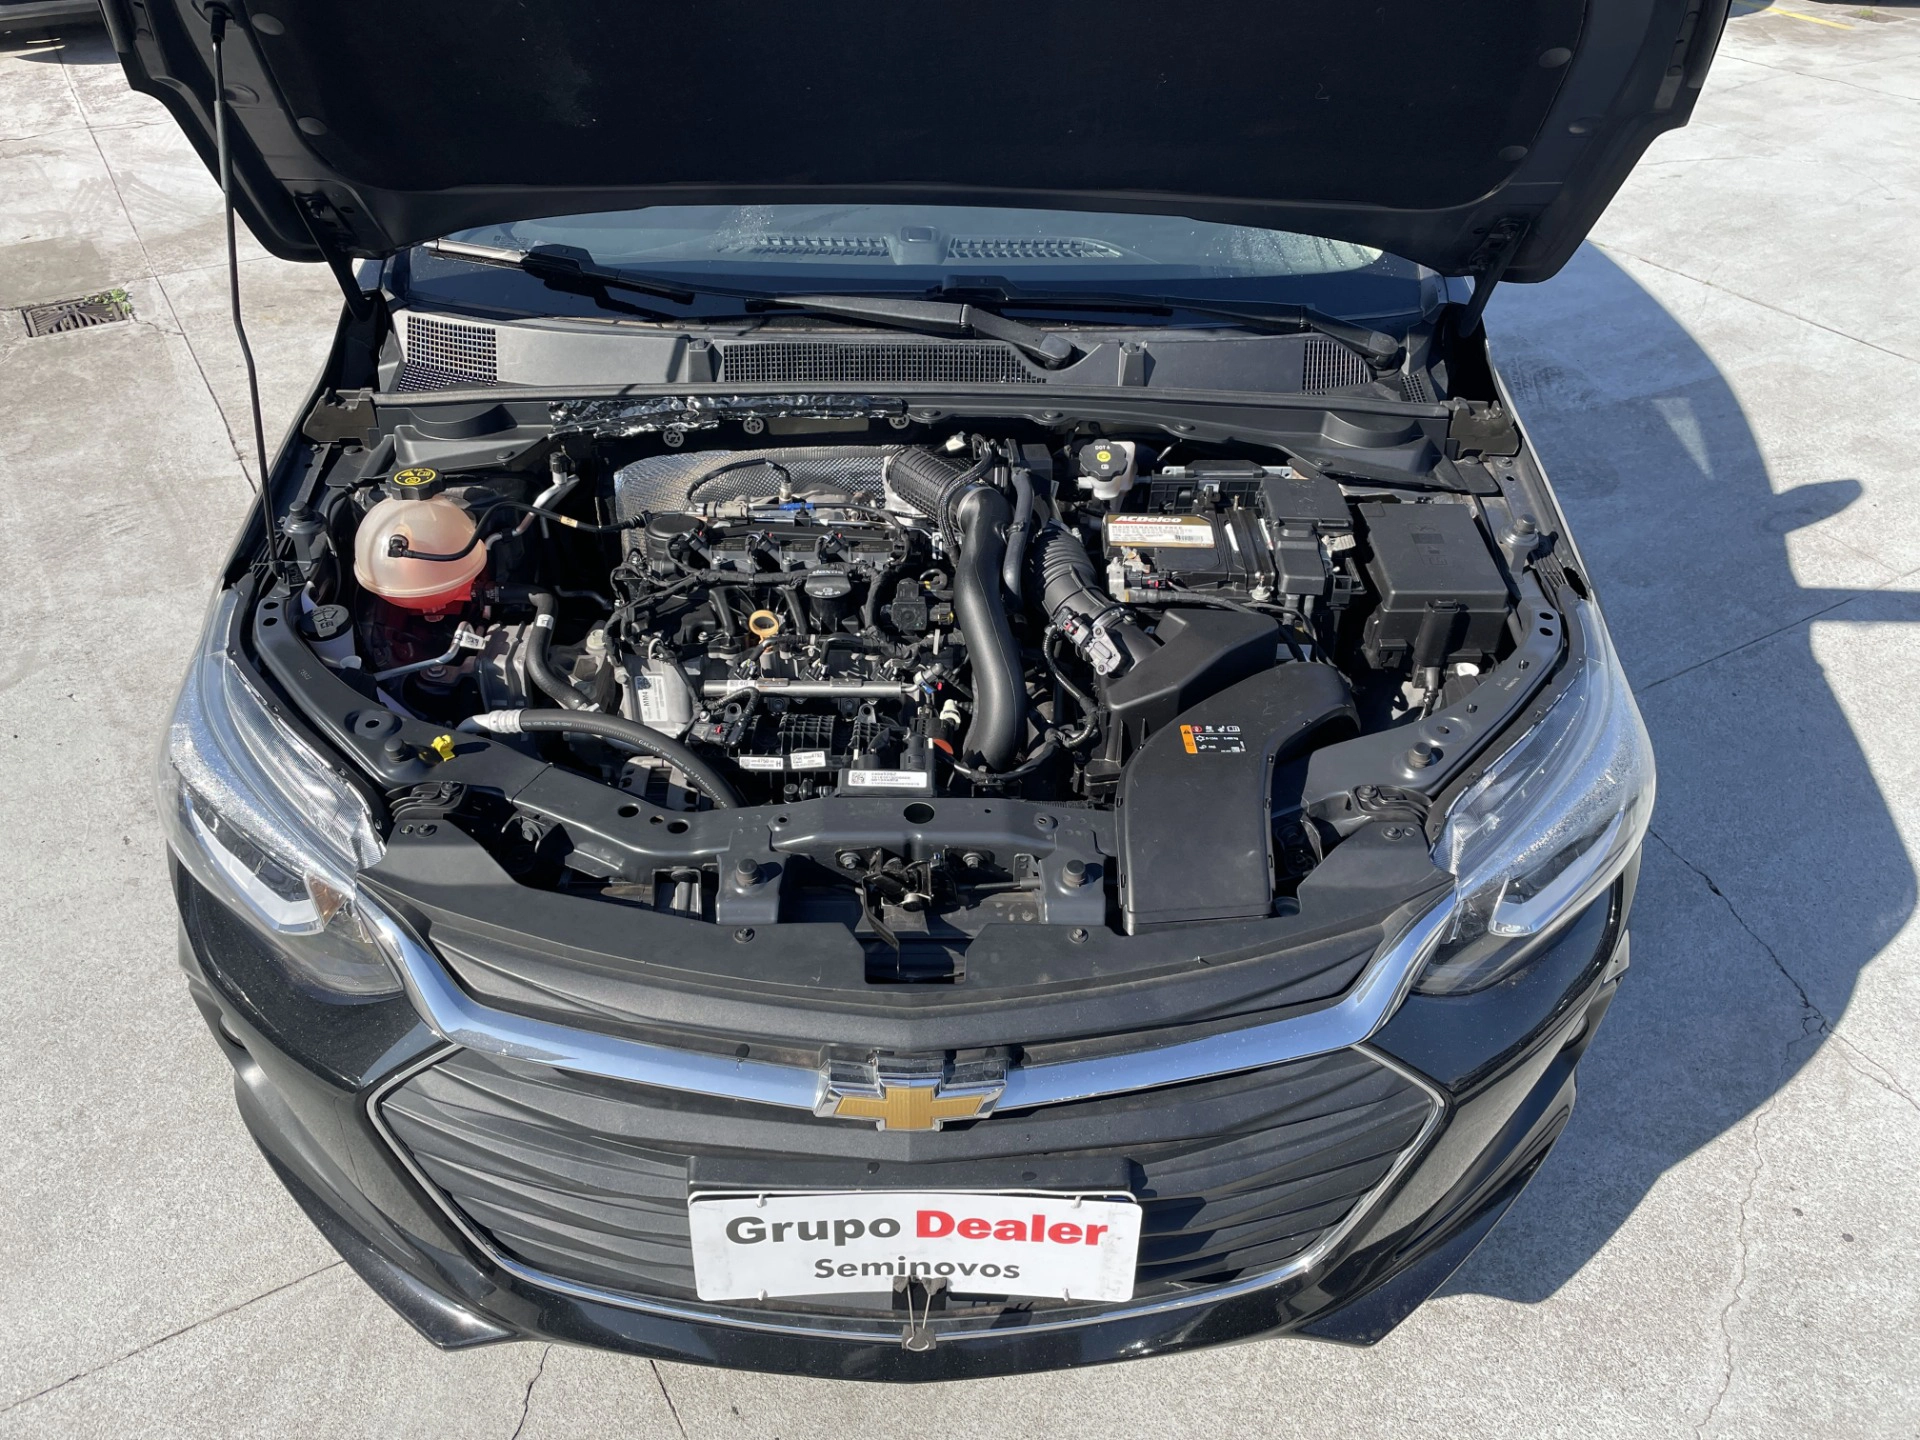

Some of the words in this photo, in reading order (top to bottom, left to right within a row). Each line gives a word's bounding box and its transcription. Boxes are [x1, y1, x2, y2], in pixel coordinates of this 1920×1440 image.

[725, 1215, 901, 1247] Grupo
[916, 1210, 1109, 1246] Dealer
[814, 1255, 1021, 1279] Seminovos
